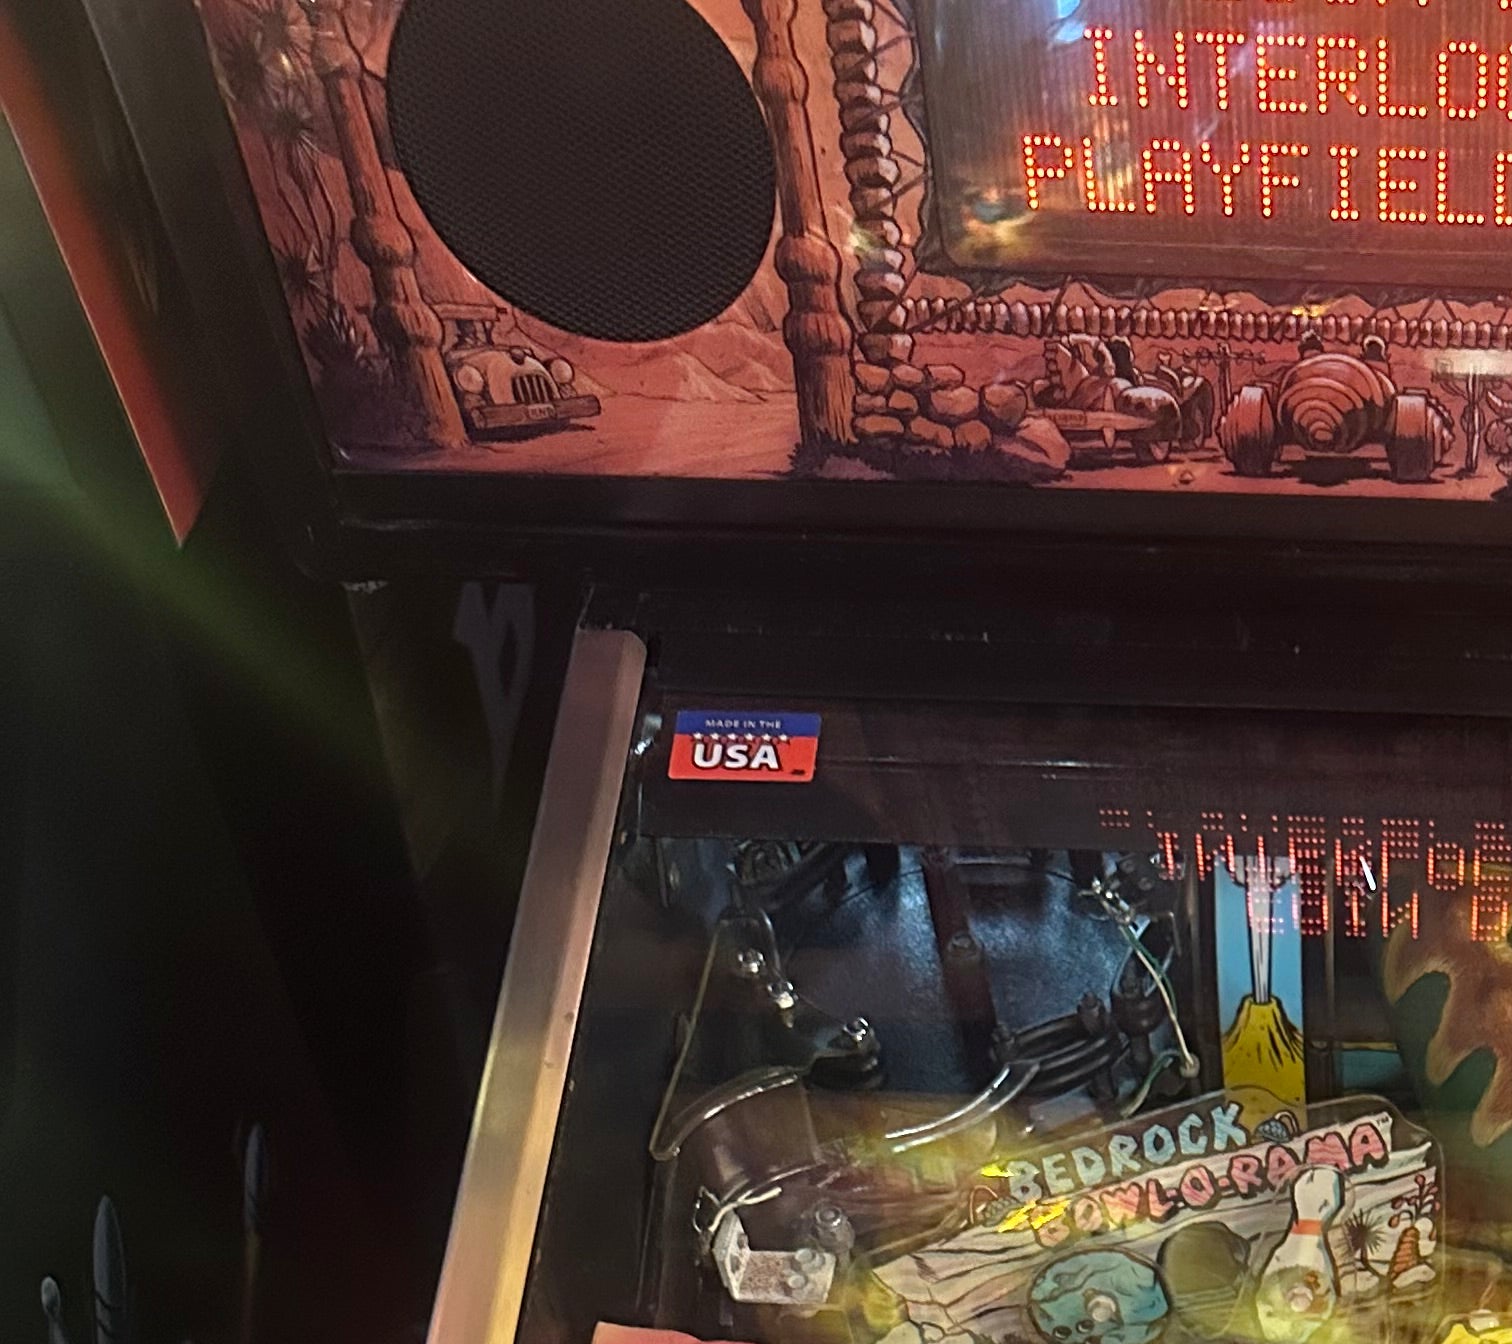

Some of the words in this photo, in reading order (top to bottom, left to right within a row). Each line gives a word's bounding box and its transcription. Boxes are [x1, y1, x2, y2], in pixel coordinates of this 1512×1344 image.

[706, 718, 740, 728] MADE
[743, 720, 756, 729] IN
[759, 720, 782, 729] THE
[692, 742, 781, 770] USA
[1007, 1101, 1249, 1203] BEDROCK
